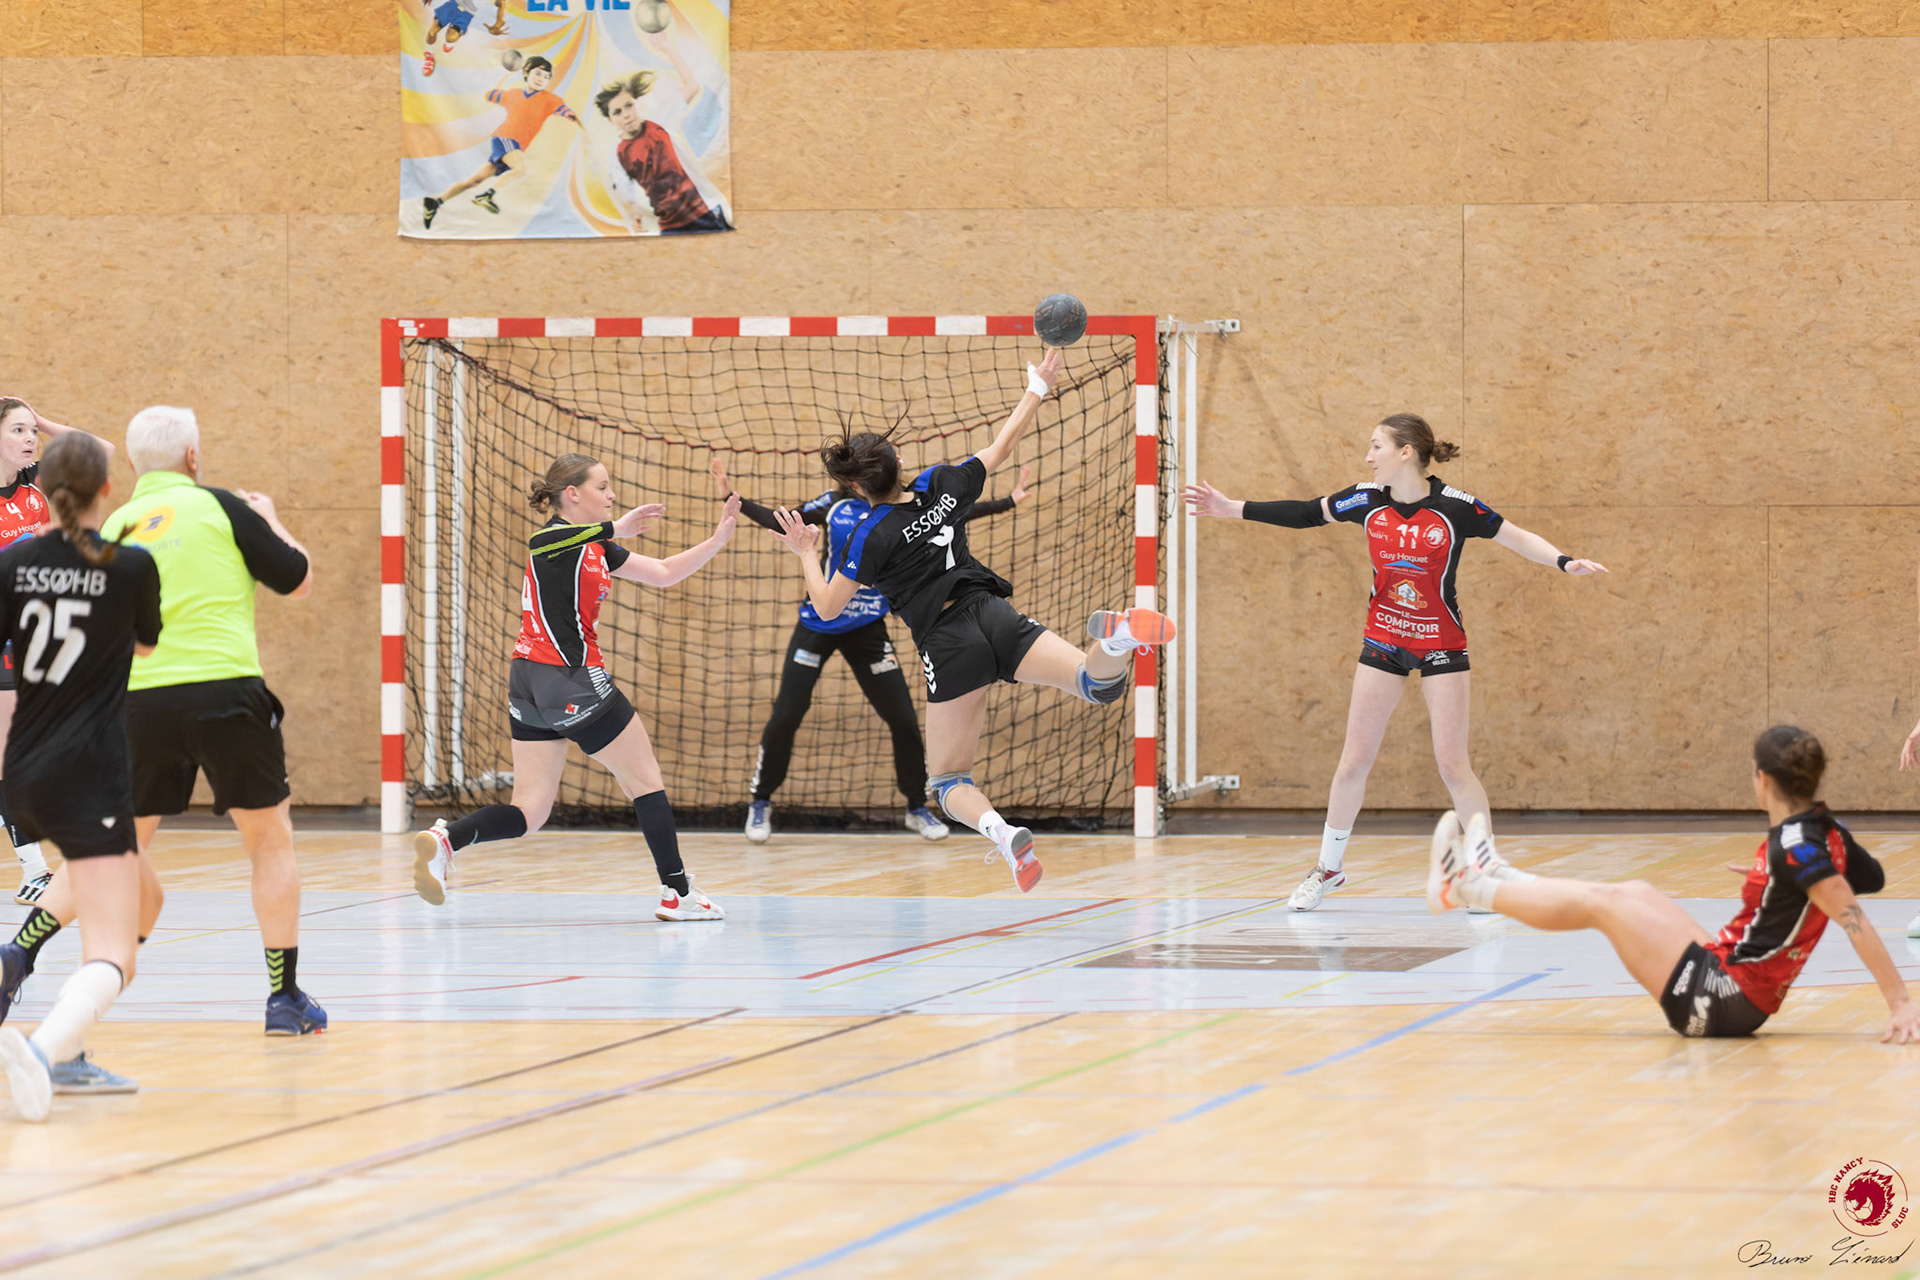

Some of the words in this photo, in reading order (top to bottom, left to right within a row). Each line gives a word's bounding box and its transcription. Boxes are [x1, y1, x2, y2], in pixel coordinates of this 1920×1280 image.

[1, 529, 18, 538] Guy
[1396, 523, 1419, 549] 11
[1379, 550, 1395, 560] Guy
[1397, 552, 1428, 563] Hoquet
[1376, 612, 1439, 633] COMPTOIR
[1401, 610, 1411, 618] LE
[19, 598, 92, 686] 25
